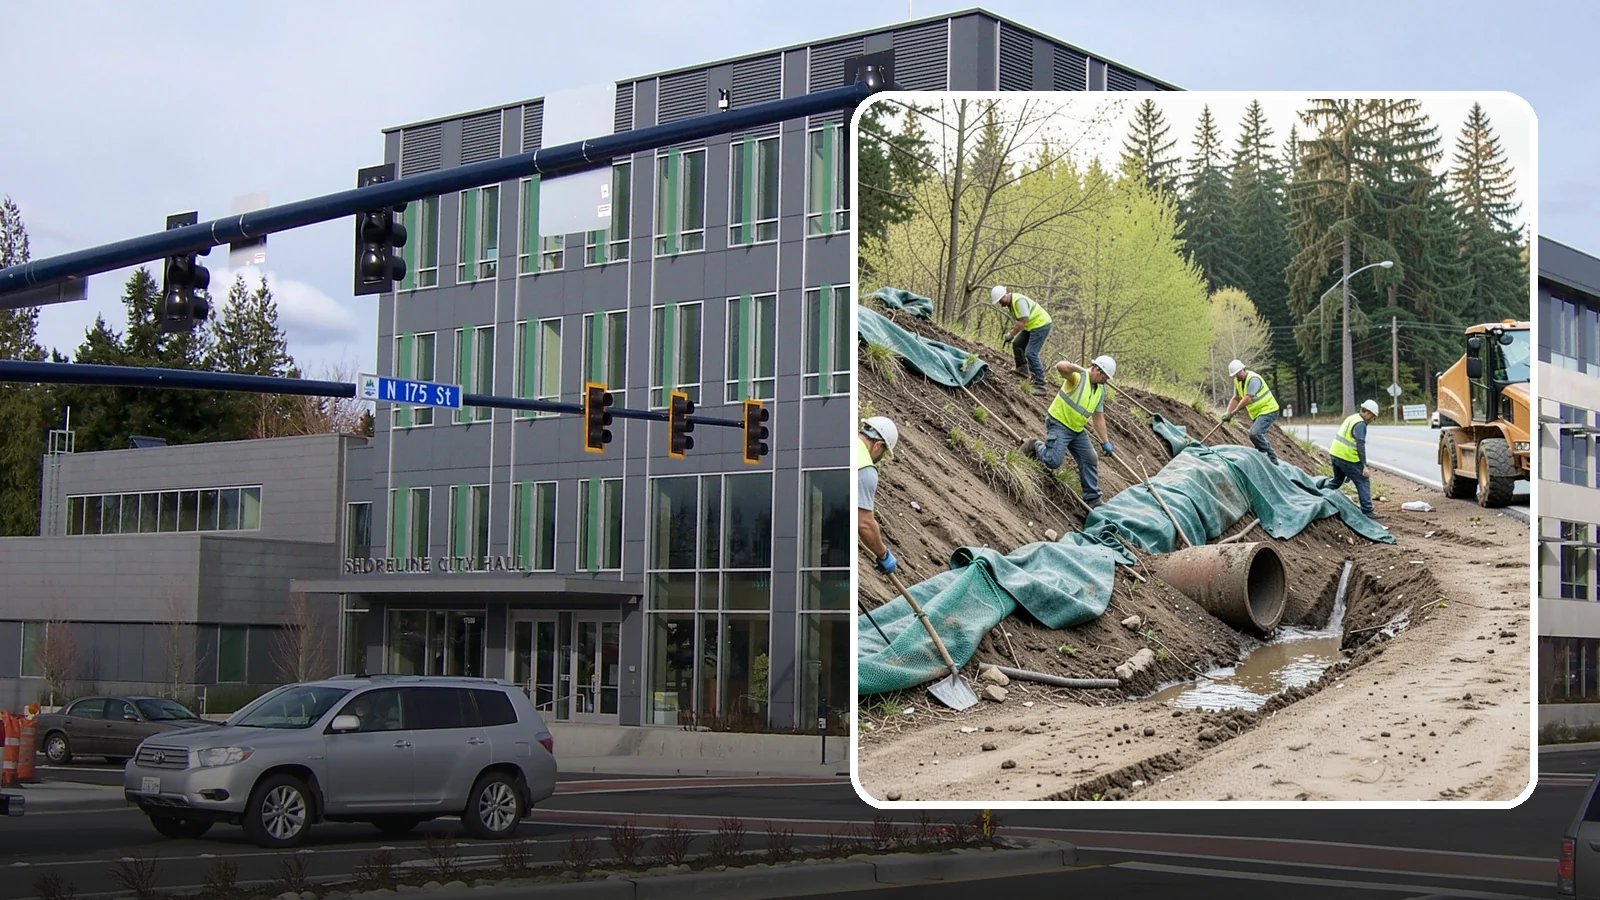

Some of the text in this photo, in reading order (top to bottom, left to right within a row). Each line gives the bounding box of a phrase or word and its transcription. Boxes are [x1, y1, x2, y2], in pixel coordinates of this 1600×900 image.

[387, 380, 451, 406] N 175 St
[344, 555, 525, 574] SHORELINE CITY HALL
